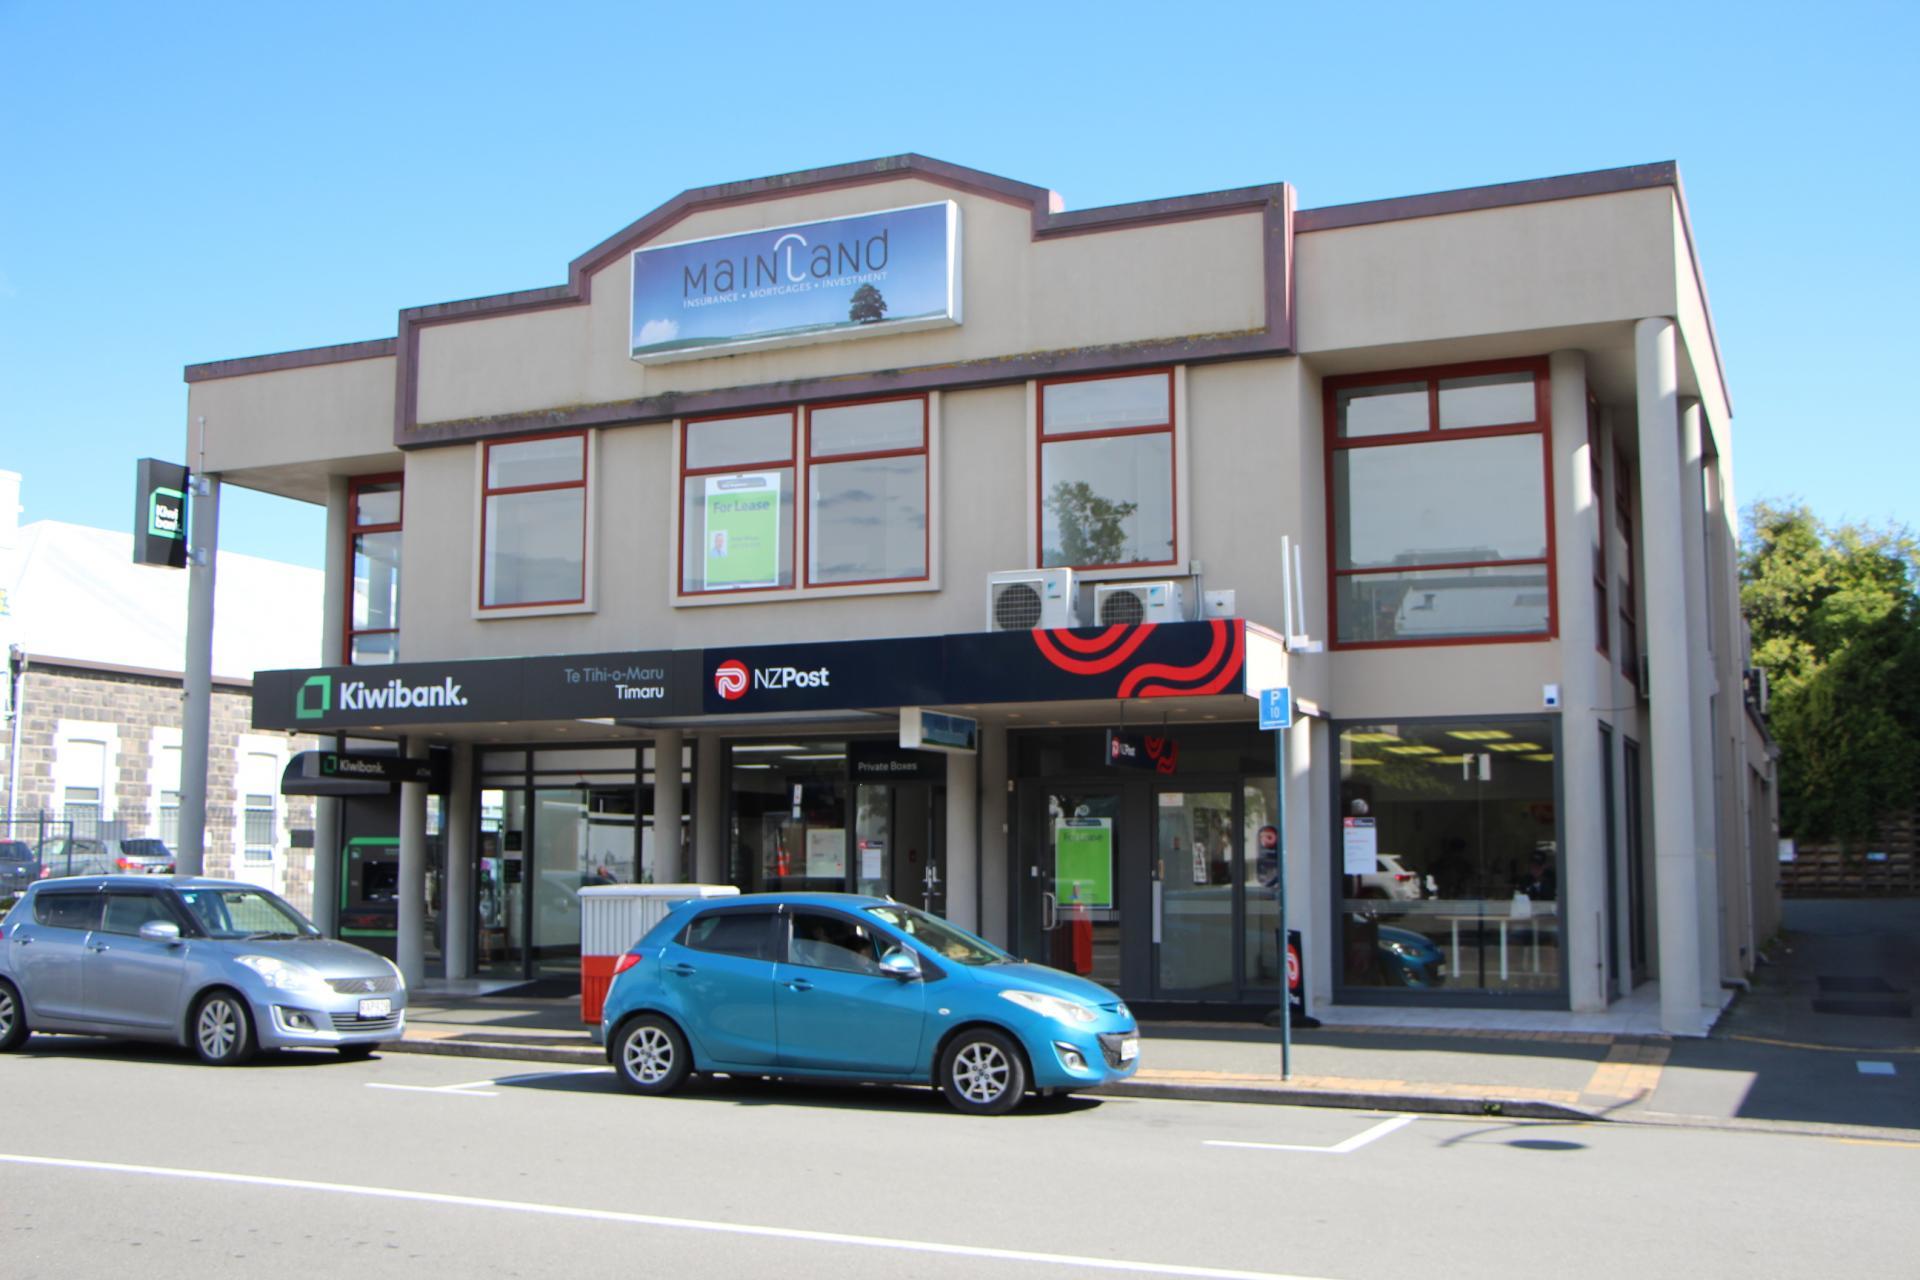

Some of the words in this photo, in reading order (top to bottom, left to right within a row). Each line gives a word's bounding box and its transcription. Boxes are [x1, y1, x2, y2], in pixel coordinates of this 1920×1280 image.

[683, 292, 739, 309] INSURANCE
[750, 282, 812, 299] MORTGAGES
[822, 271, 888, 289] INVESTMENT
[155, 504, 179, 520] Kiwi
[713, 501, 733, 514] For
[735, 499, 770, 513] Lease
[563, 667, 581, 683] Te
[583, 665, 664, 683] Tihi-o-Maru
[754, 667, 830, 689] NZPost
[339, 676, 468, 711] Kiwibank.
[615, 684, 665, 699] Timaru
[1270, 690, 1281, 705] P
[857, 761, 889, 772] Private
[889, 760, 918, 772] Boxes
